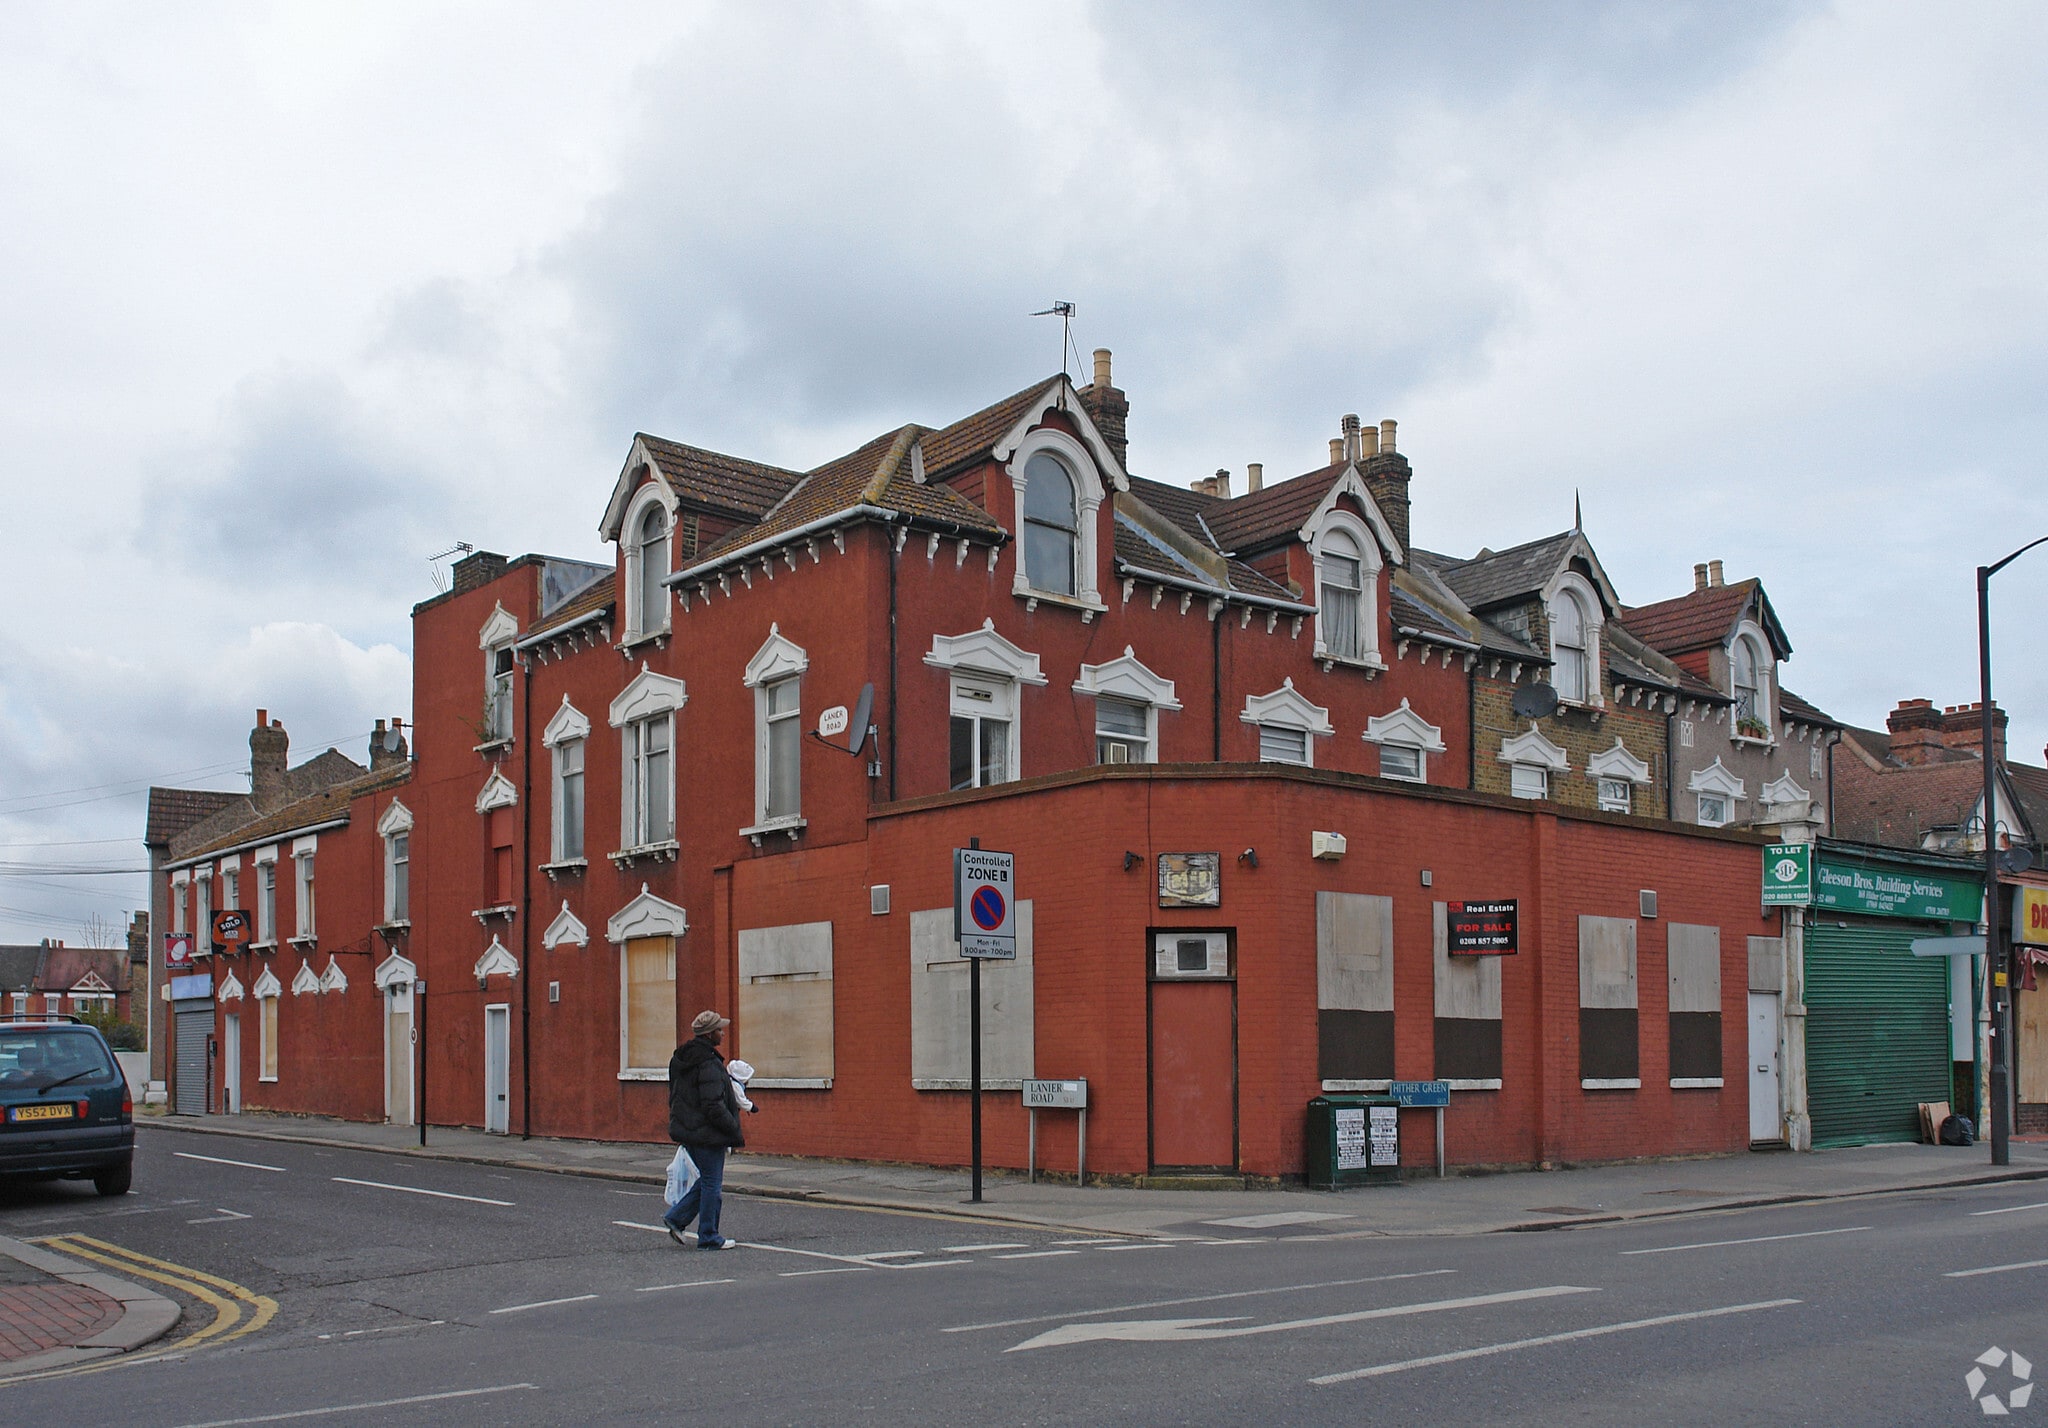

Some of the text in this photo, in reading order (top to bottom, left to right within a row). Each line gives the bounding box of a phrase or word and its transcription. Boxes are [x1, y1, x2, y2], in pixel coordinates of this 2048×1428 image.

[823, 710, 843, 721] LANIER
[826, 721, 841, 730] ROAD
[1770, 846, 1802, 855] TO LET
[964, 853, 1011, 867] Controlled
[967, 867, 998, 881] ZONE
[1819, 867, 1943, 898] Gleeson Bros. Building Services
[1466, 905, 1486, 913] Real
[1488, 904, 1514, 912] Estate
[220, 918, 241, 931] SOLD
[1456, 922, 1512, 932] FOR SALE
[1459, 937, 1477, 945] 0208
[1030, 1082, 1063, 1092] LANIER
[1393, 1082, 1447, 1093] HITHER GREEN
[1030, 1093, 1055, 1103] ROAD
[17, 1105, 71, 1118] YS52 DVX
